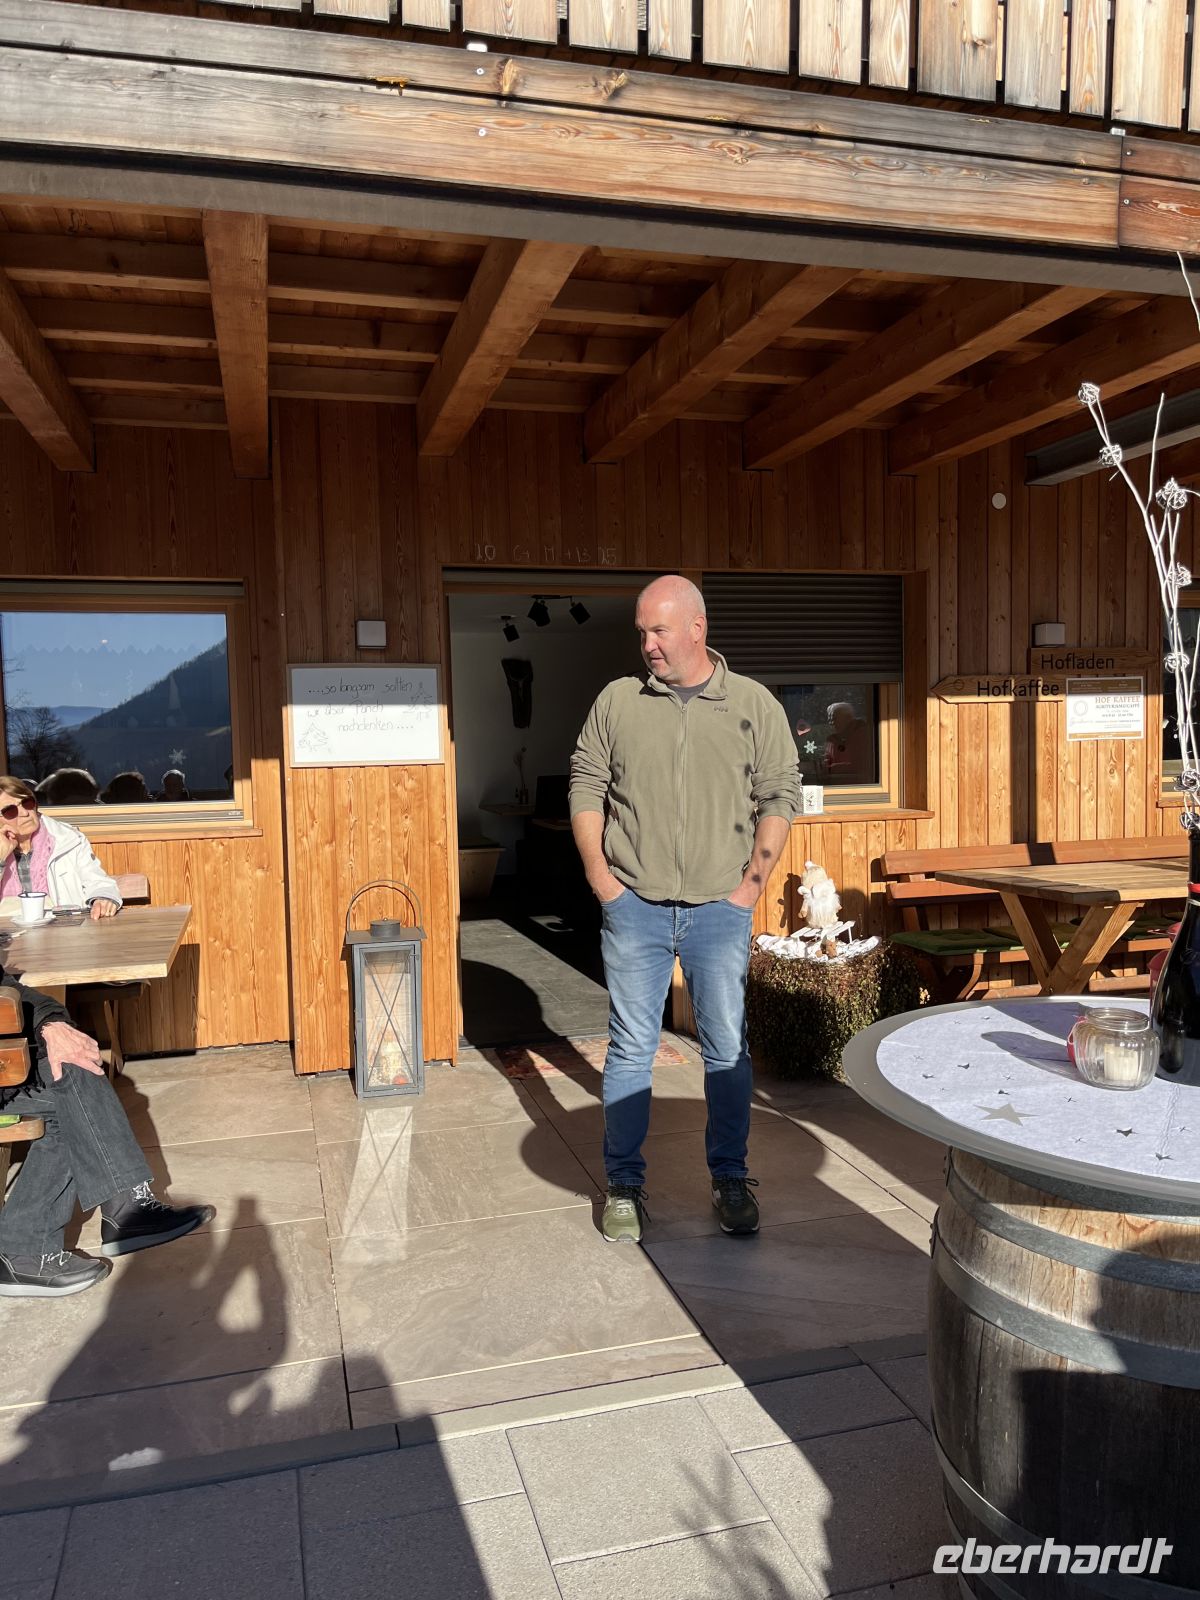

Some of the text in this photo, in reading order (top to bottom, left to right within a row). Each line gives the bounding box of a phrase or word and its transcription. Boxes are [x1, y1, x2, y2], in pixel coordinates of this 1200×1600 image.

[1041, 654, 1115, 670] Hofladen
[977, 679, 1060, 697] Hofkaffee
[1095, 695, 1141, 704] HOF KAFFEE
